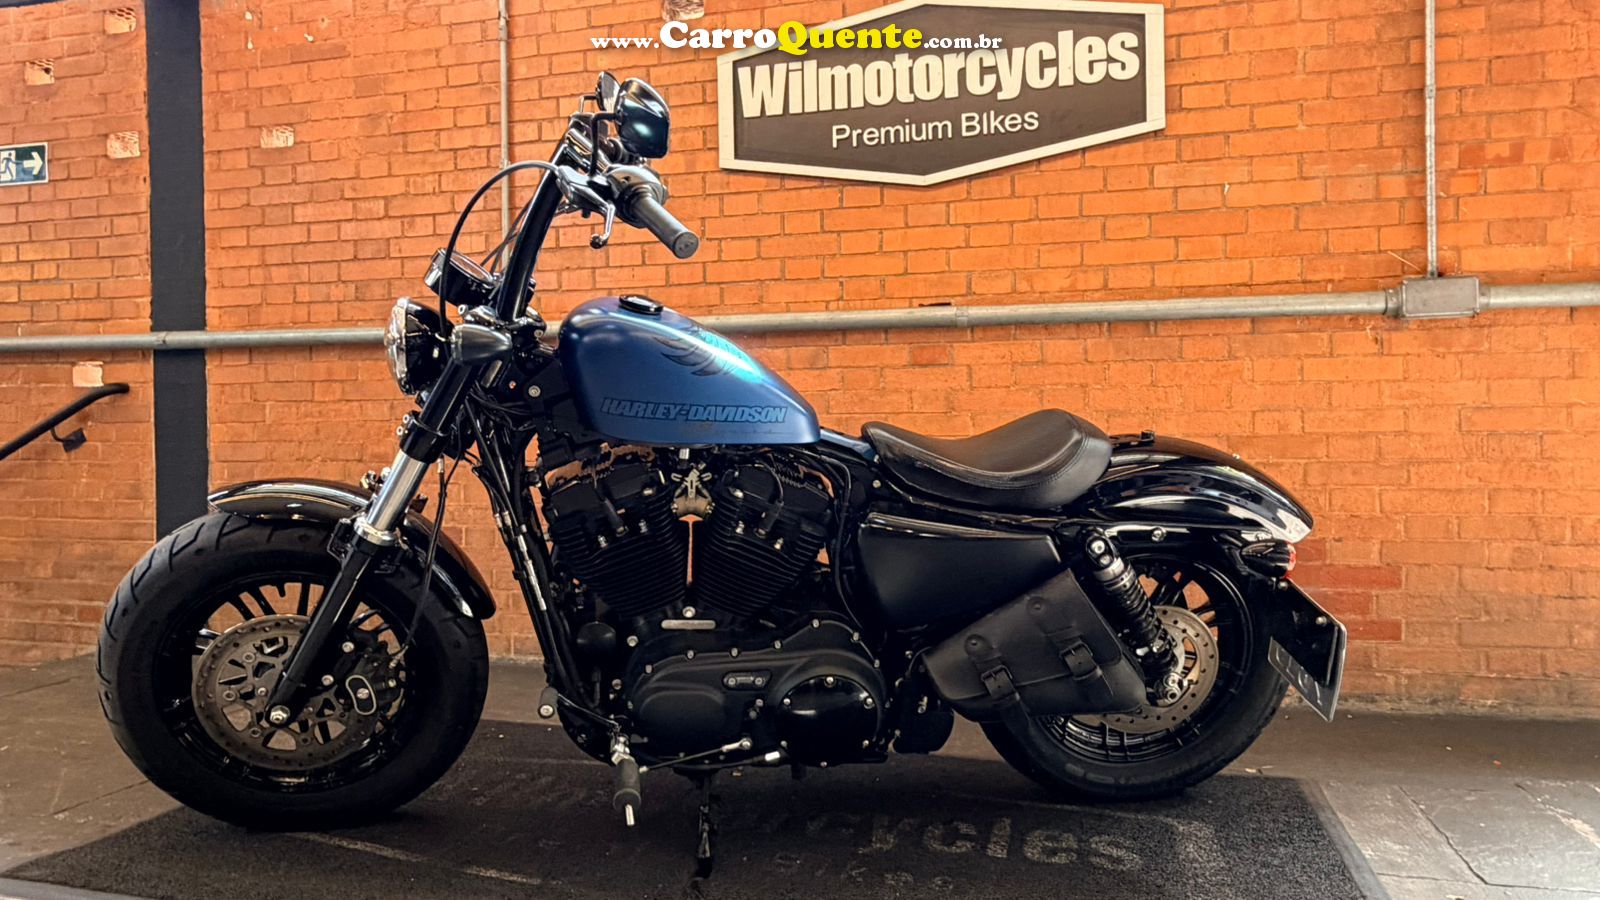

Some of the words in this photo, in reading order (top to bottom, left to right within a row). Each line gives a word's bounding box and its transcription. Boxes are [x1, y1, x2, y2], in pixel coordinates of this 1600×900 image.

[737, 30, 1140, 118] Wilmotorcycles
[831, 118, 952, 148] Premium
[601, 397, 788, 424] HARLEY-DAVIDSON
